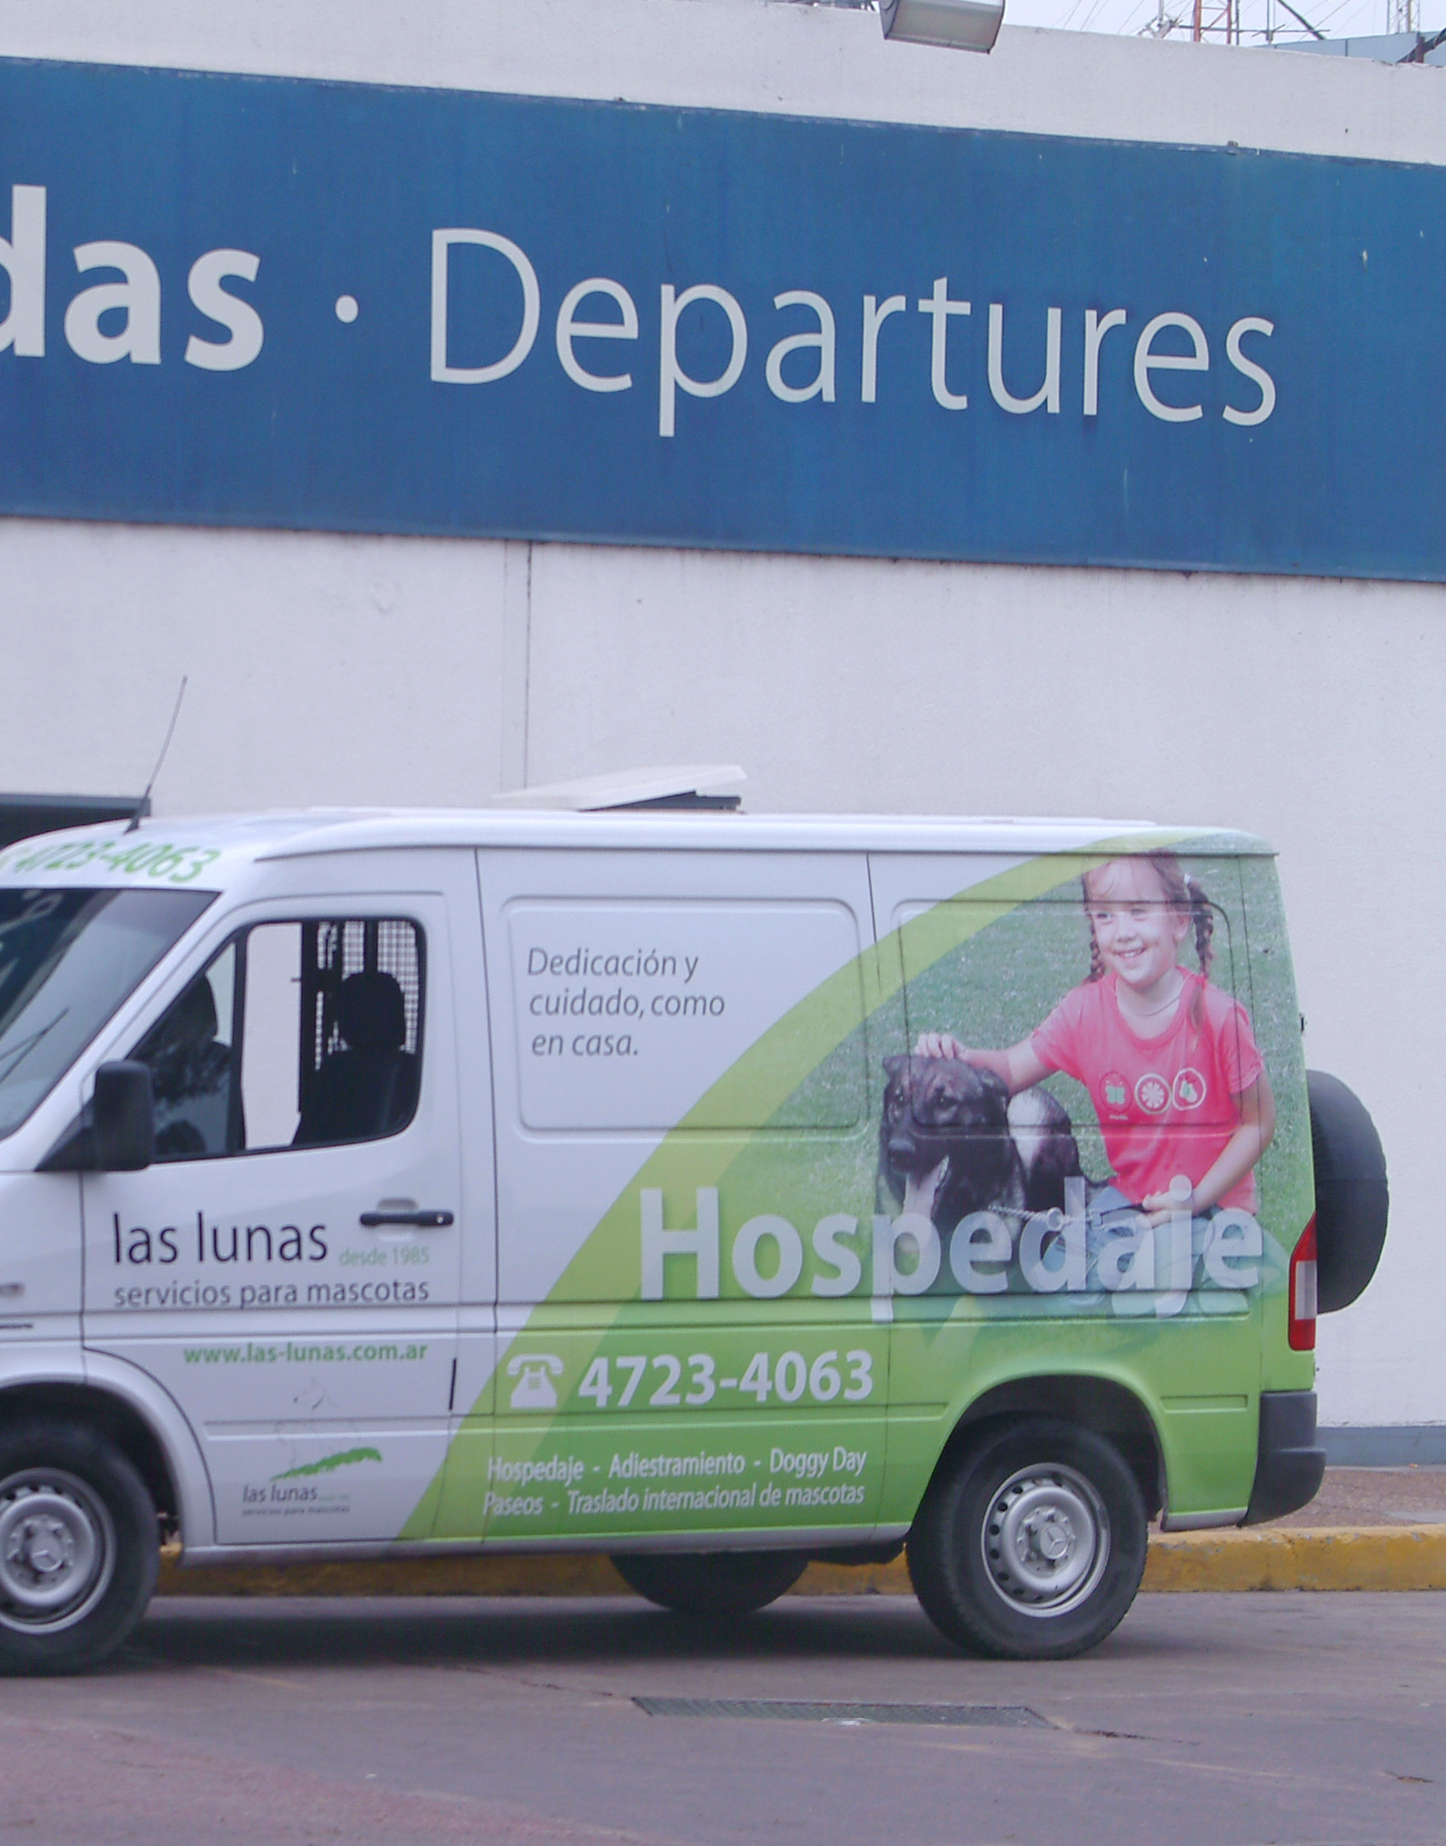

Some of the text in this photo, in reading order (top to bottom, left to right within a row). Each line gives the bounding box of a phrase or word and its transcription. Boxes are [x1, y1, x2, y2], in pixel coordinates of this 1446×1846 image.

[430, 228, 1276, 437] Departures
[527, 947, 699, 984] Dedicación y
[530, 988, 725, 1020] cuidado, como
[531, 1033, 639, 1056] en casa.
[114, 1212, 178, 1264] las
[198, 1211, 327, 1262] lunas
[339, 1248, 386, 1266] desde
[639, 1174, 1264, 1322] Hospedaje
[114, 1279, 429, 1310] servicios para mascotas
[183, 1342, 428, 1364] www.las-lunas.com.ar
[577, 1350, 873, 1407] 4723-4063
[487, 1456, 584, 1487] Hospedaje
[608, 1451, 746, 1479] Adiestramiento
[769, 1448, 830, 1479] Doggy
[833, 1446, 867, 1477] Day
[242, 1484, 318, 1503] las lunas
[482, 1491, 544, 1515] Paseos
[567, 1488, 640, 1514] Traslado
[643, 1483, 757, 1512] internacional
[759, 1483, 781, 1506] de
[784, 1483, 866, 1506] mascotas
